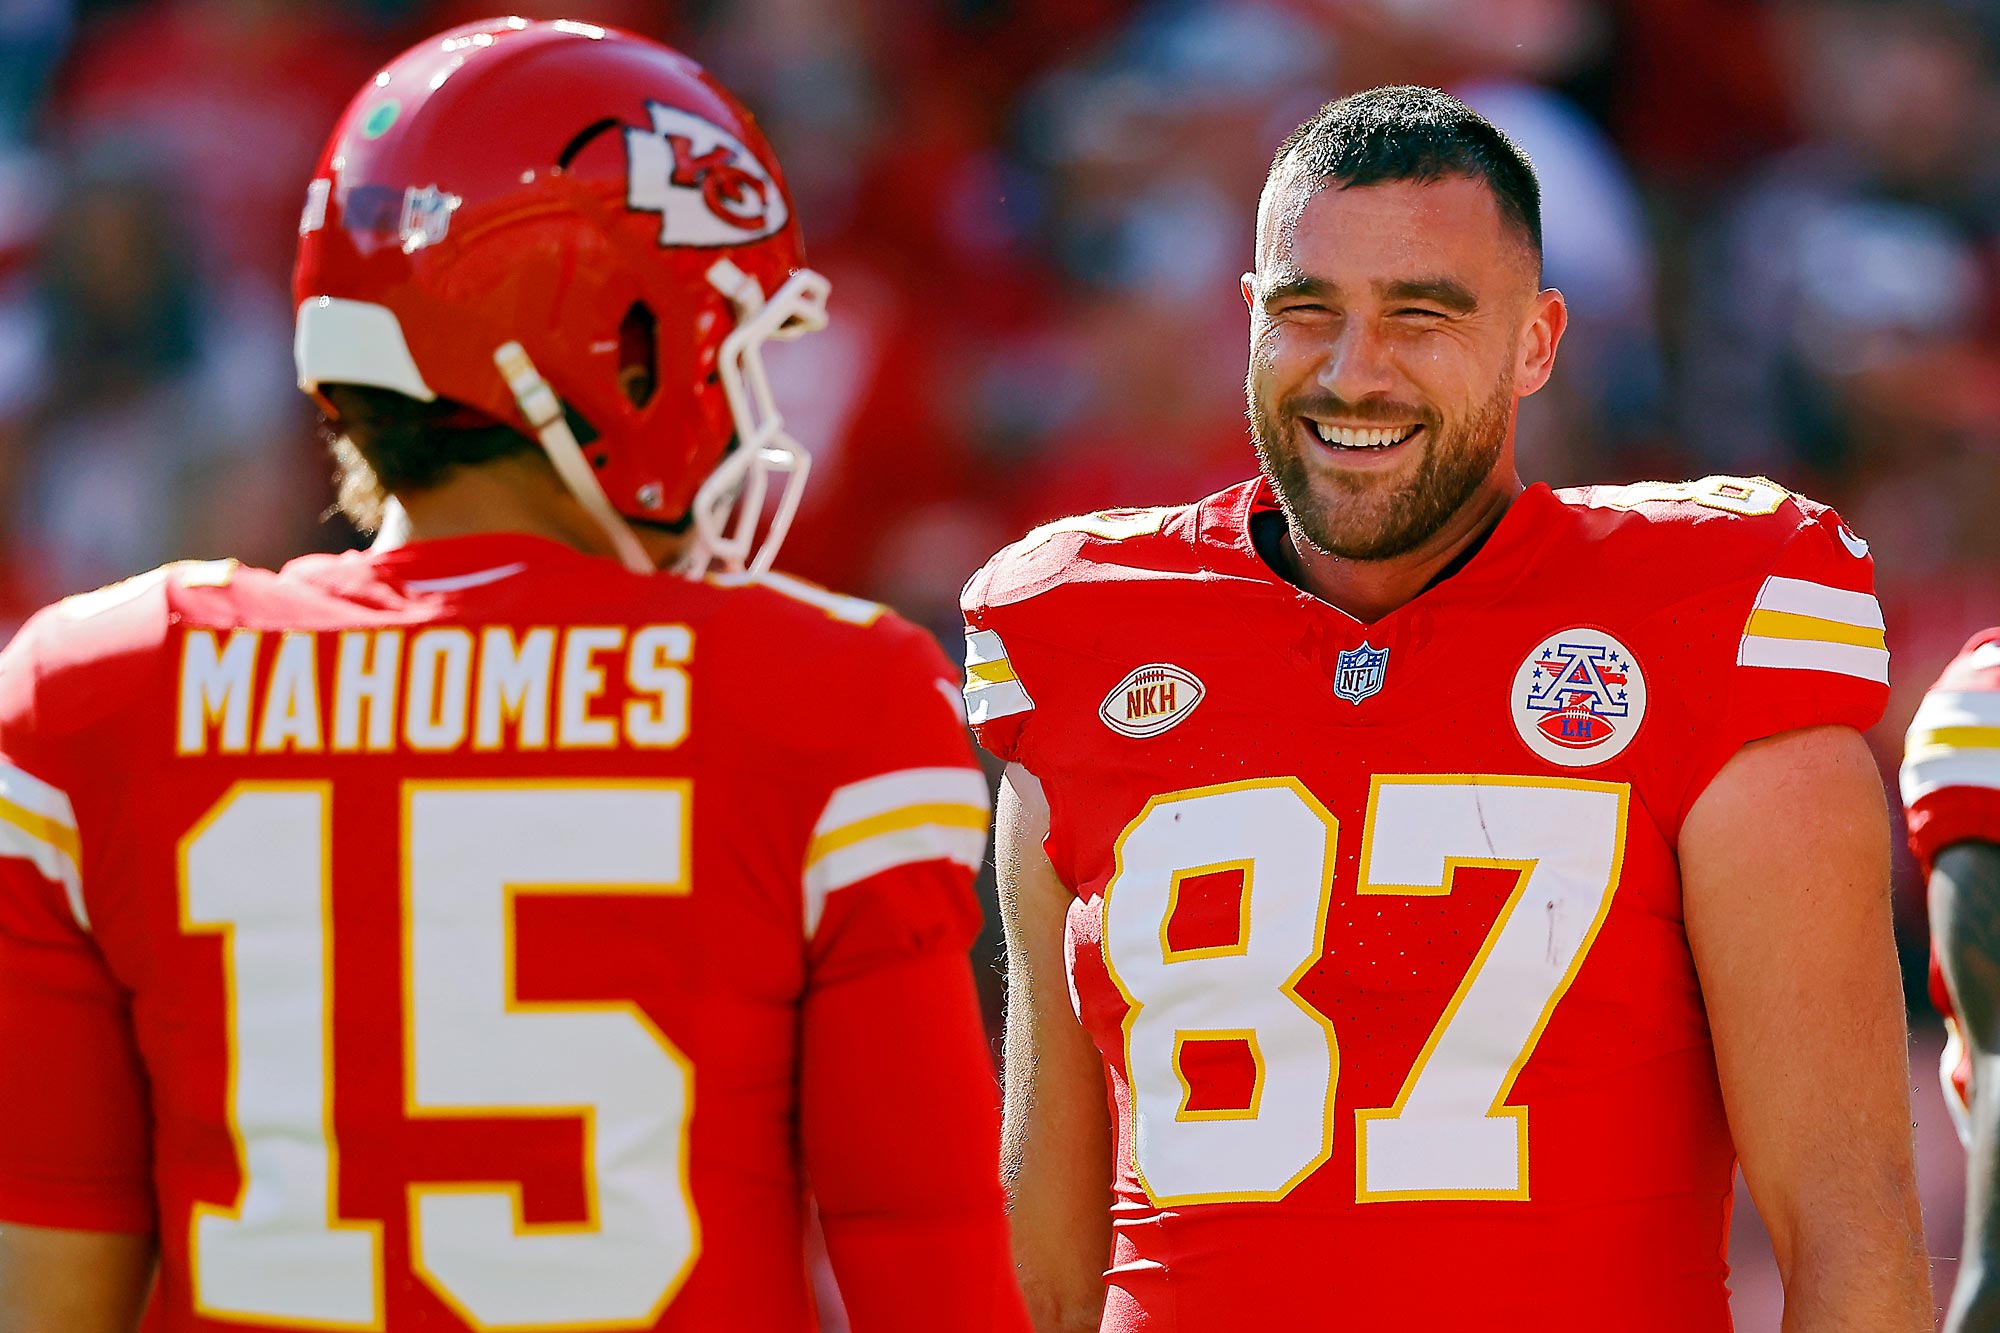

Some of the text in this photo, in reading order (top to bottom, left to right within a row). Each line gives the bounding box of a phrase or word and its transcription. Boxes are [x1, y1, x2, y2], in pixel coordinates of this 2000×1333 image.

[177, 624, 694, 756] MAHOMES
[1126, 681, 1176, 720] NKH
[1342, 669, 1374, 691] NFL
[1561, 719, 1592, 737] LH
[1103, 773, 1631, 1208] 87
[178, 778, 702, 1333] 15
